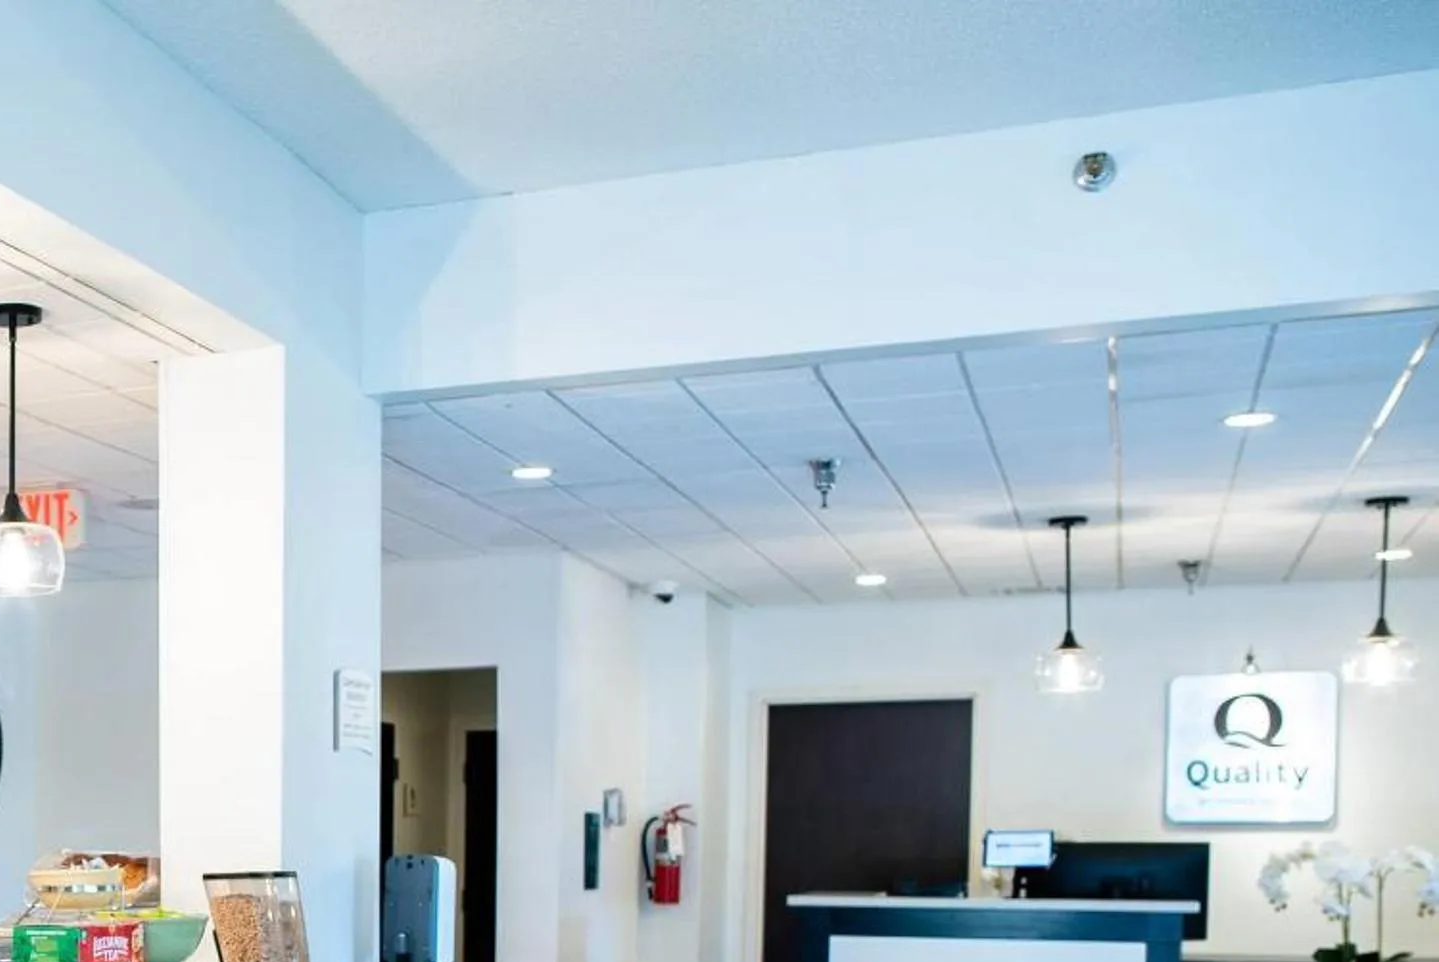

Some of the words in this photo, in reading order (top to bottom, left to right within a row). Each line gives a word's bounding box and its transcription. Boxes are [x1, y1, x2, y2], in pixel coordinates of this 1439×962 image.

[17, 491, 69, 541] XIT
[1214, 692, 1288, 749] Q
[1187, 760, 1310, 791] Quality
